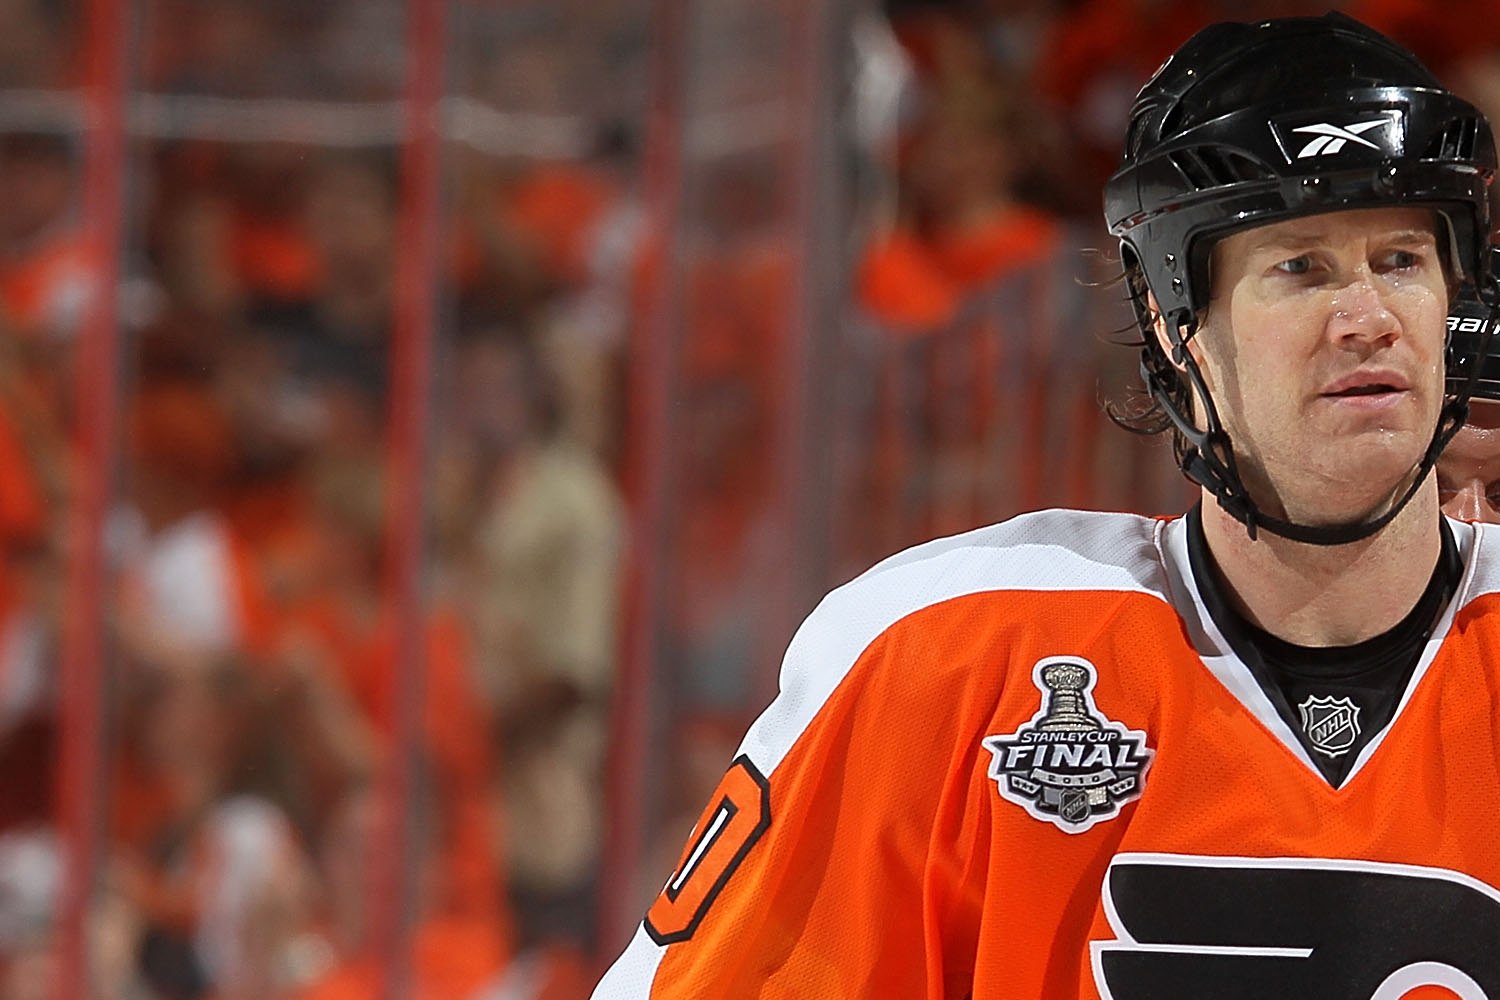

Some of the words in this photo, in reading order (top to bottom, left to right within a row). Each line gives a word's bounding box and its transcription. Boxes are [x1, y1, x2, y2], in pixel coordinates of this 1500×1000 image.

[1315, 712, 1351, 742] NHL
[1021, 731, 1087, 744] STANLEY
[1087, 730, 1119, 743] CUP
[1005, 744, 1139, 768] FINAL
[1047, 775, 1100, 785] 2010
